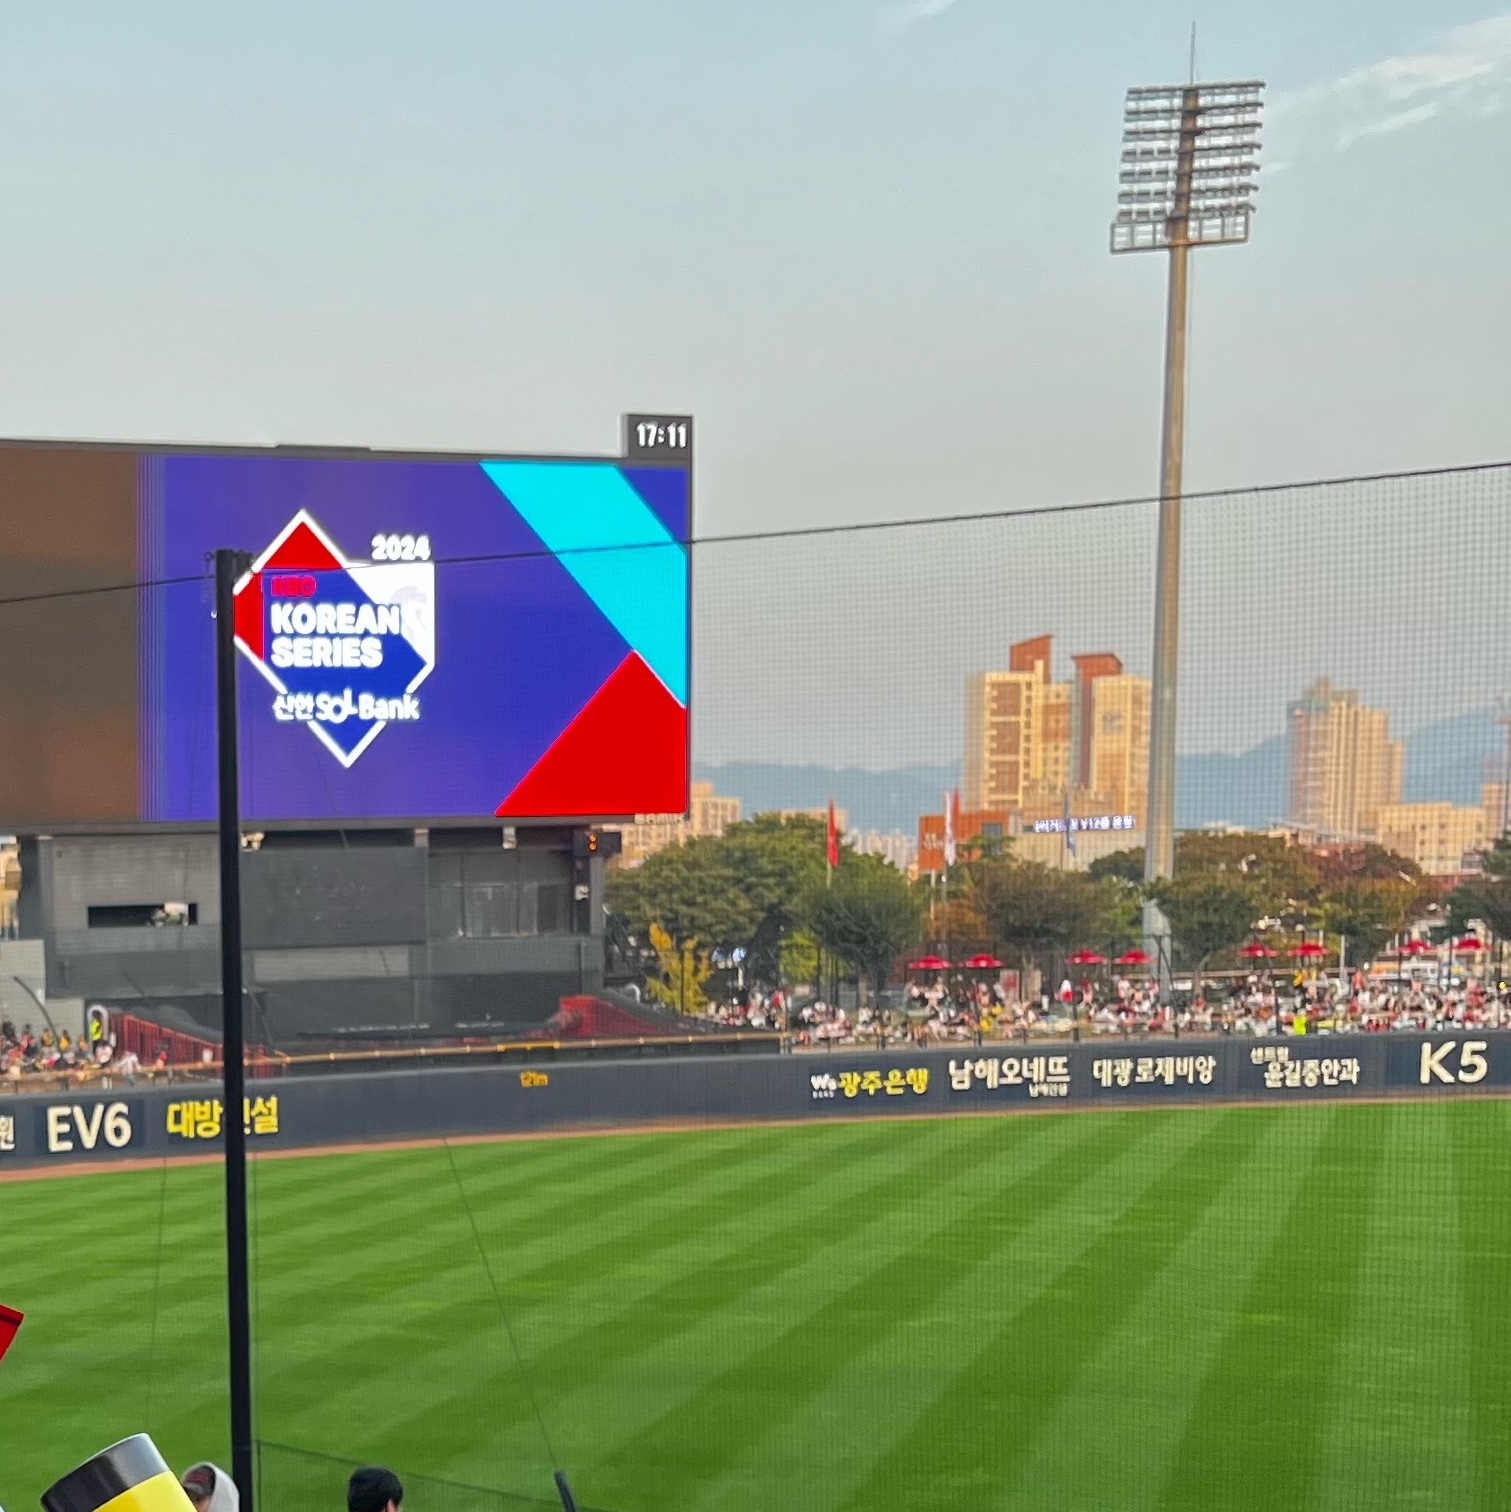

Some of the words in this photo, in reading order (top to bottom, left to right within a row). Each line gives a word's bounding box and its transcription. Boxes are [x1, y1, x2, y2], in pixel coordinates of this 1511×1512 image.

[636, 421, 687, 449] 17:11
[371, 534, 432, 560] 2024
[270, 603, 401, 634] KOREAN
[270, 636, 383, 668] SERIES
[358, 692, 421, 720] Bank
[948, 1056, 1071, 1091] 남해오네뜨
[1419, 1040, 1490, 1086] K5
[838, 1068, 930, 1098] 광주은행
[46, 1101, 133, 1154] EV6
[166, 1094, 279, 1140] 대방설
